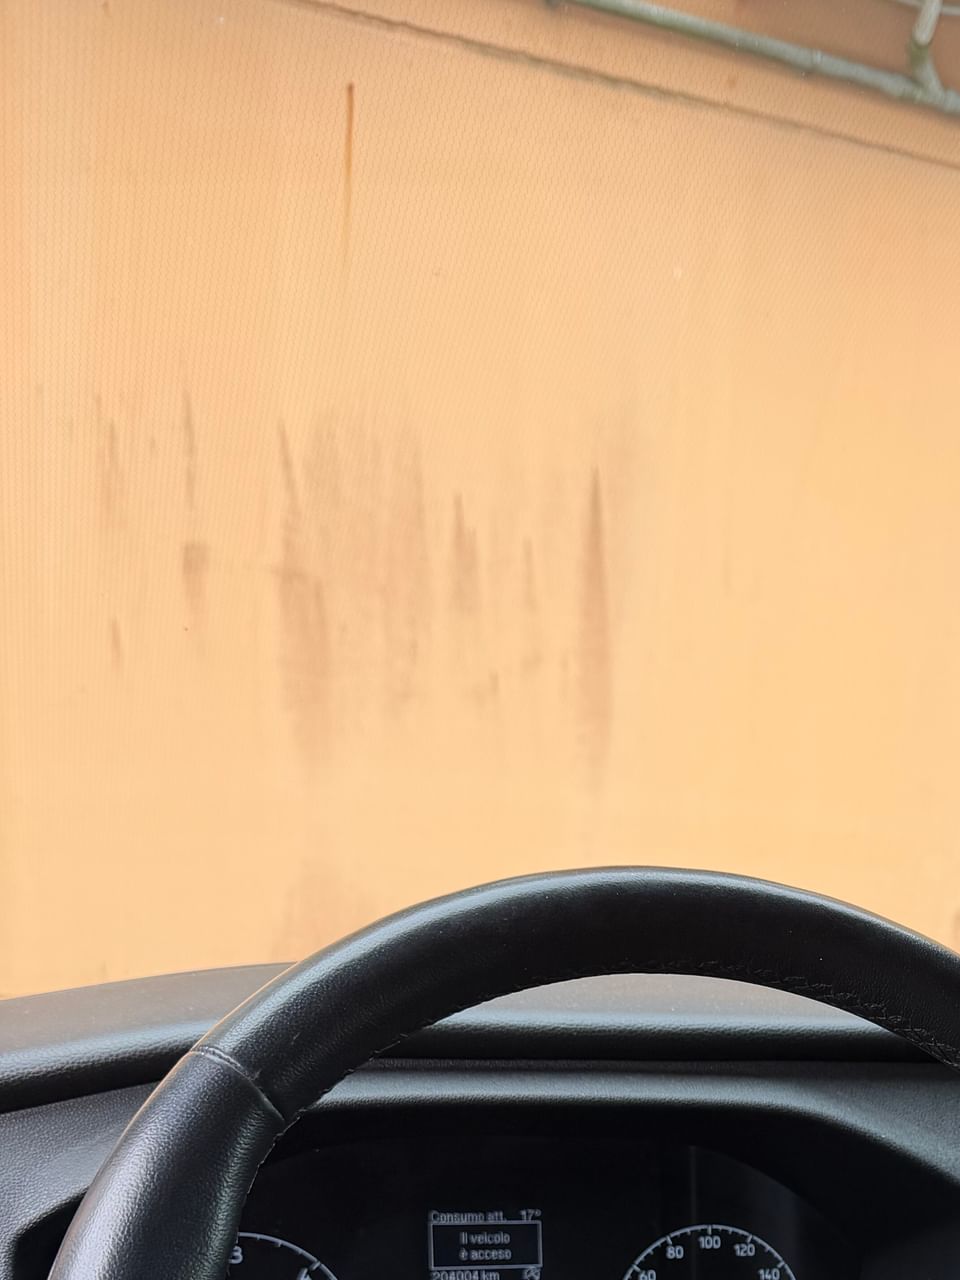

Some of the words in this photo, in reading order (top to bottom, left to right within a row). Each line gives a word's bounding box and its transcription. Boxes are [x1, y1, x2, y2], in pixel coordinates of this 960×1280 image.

[431, 1210, 485, 1224] Consumo
[520, 1209, 542, 1221] 17°
[470, 1231, 511, 1244] veicolo
[698, 1235, 721, 1249] 100
[229, 1246, 243, 1264] 3
[471, 1249, 512, 1260] acceso
[666, 1246, 684, 1260] 80
[734, 1243, 755, 1257] 120
